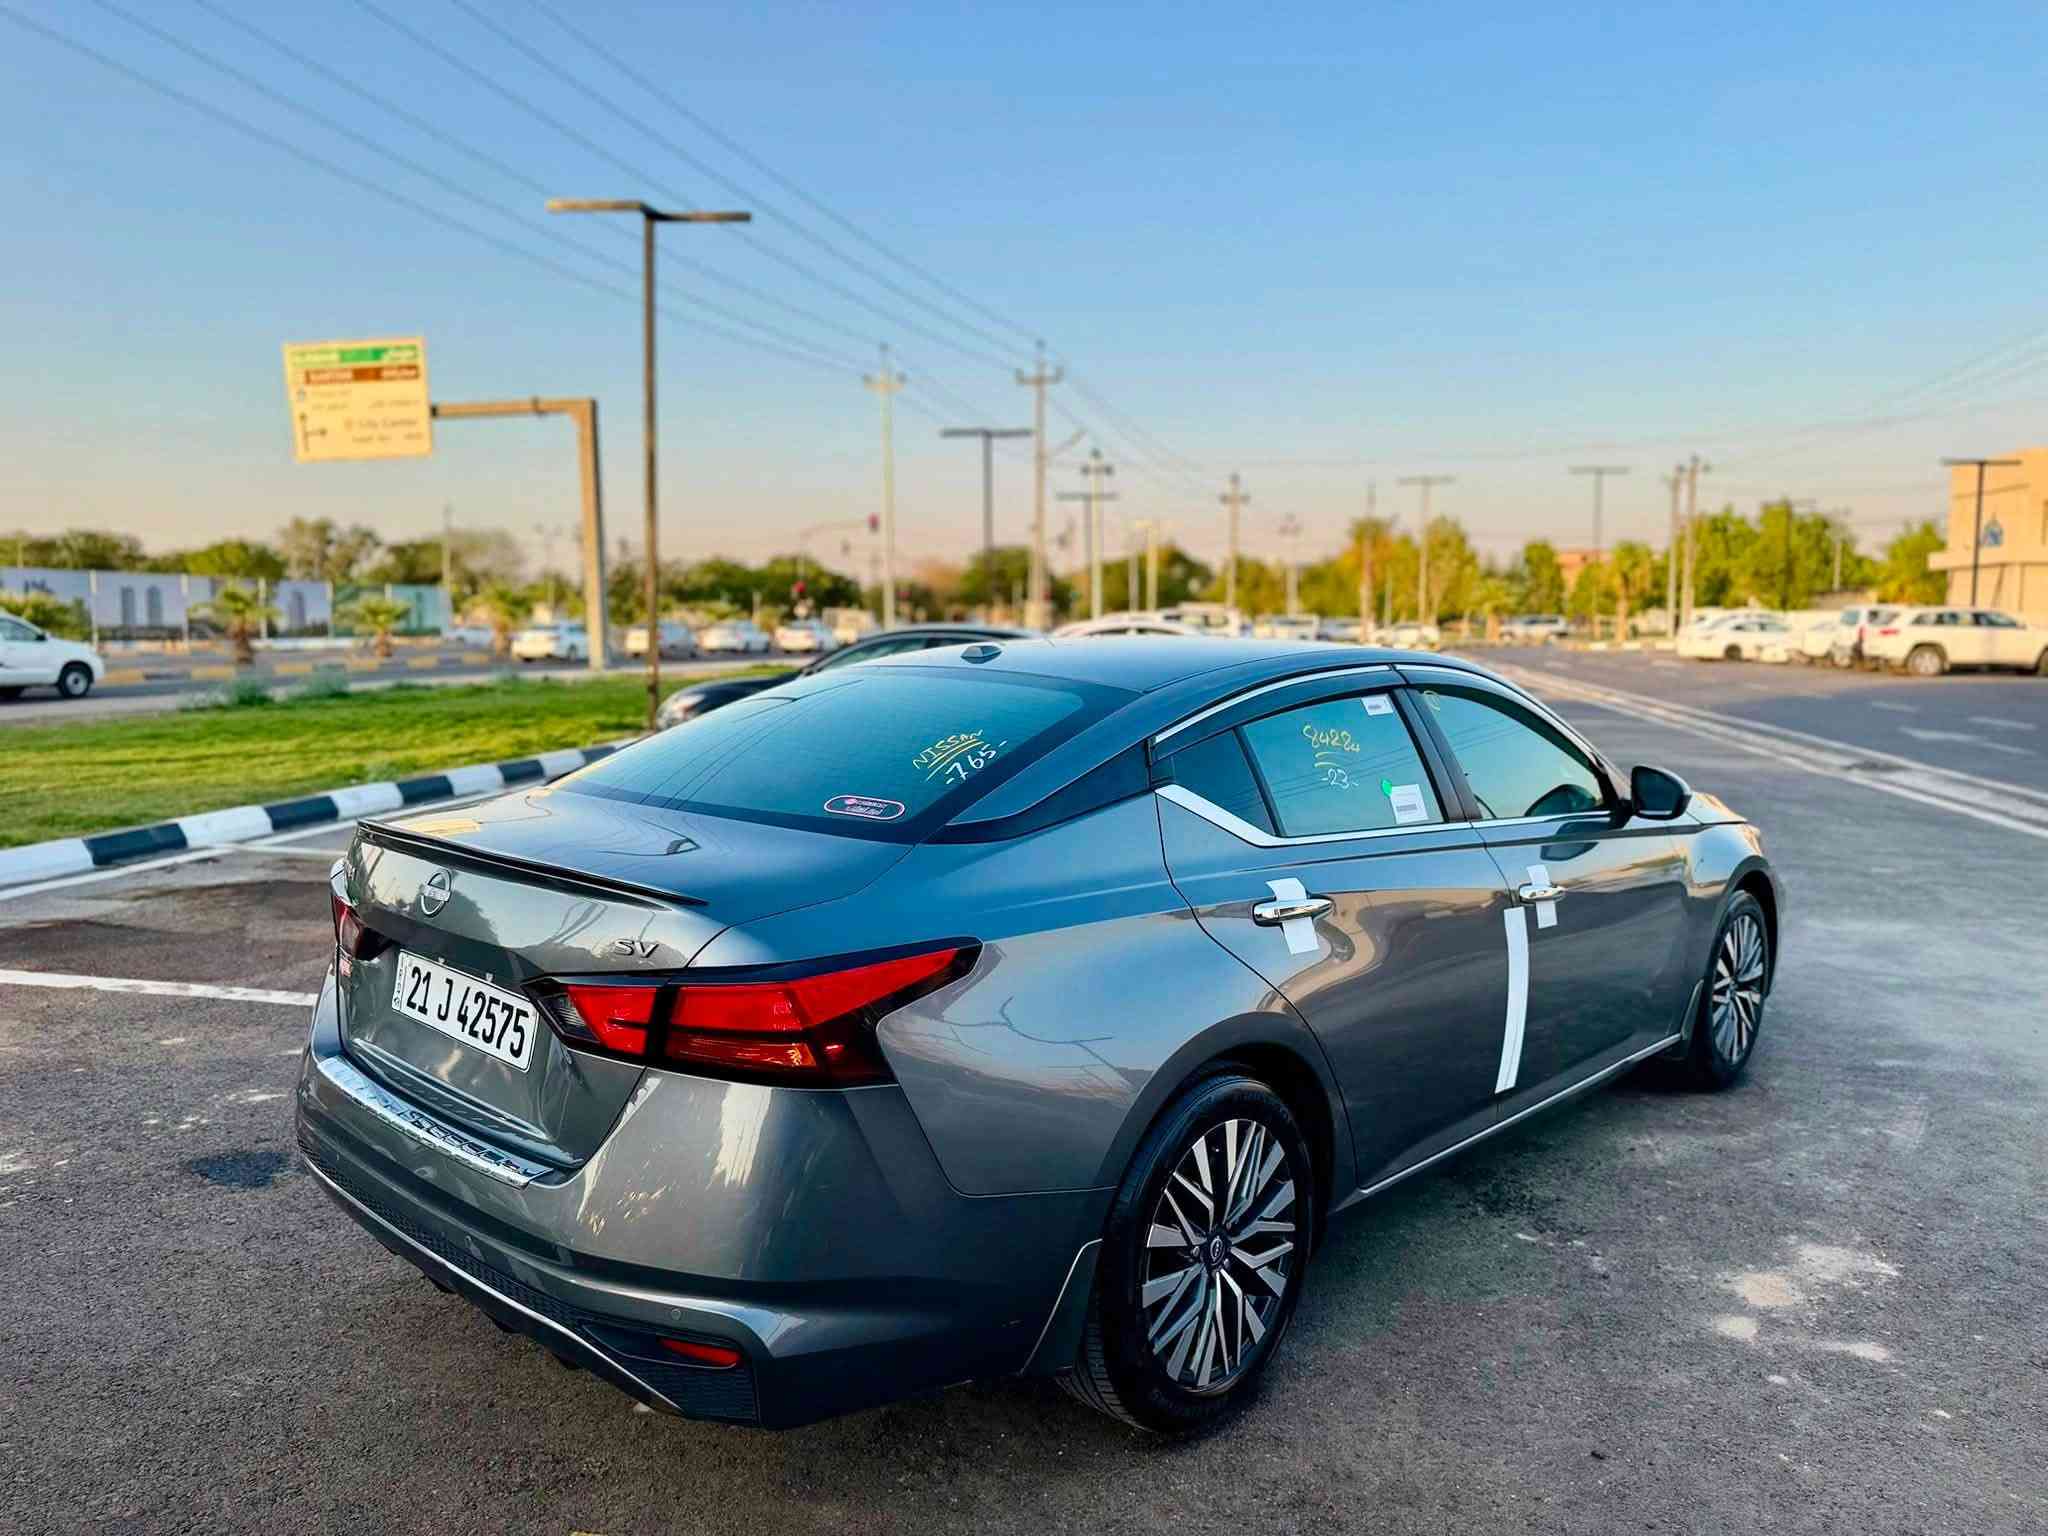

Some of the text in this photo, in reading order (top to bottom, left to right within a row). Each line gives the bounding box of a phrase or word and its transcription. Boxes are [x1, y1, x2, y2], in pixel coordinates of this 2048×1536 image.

[614, 938, 660, 958] SV
[406, 966, 432, 1016] 21
[437, 977, 454, 1021] J
[457, 986, 530, 1058] 42575
